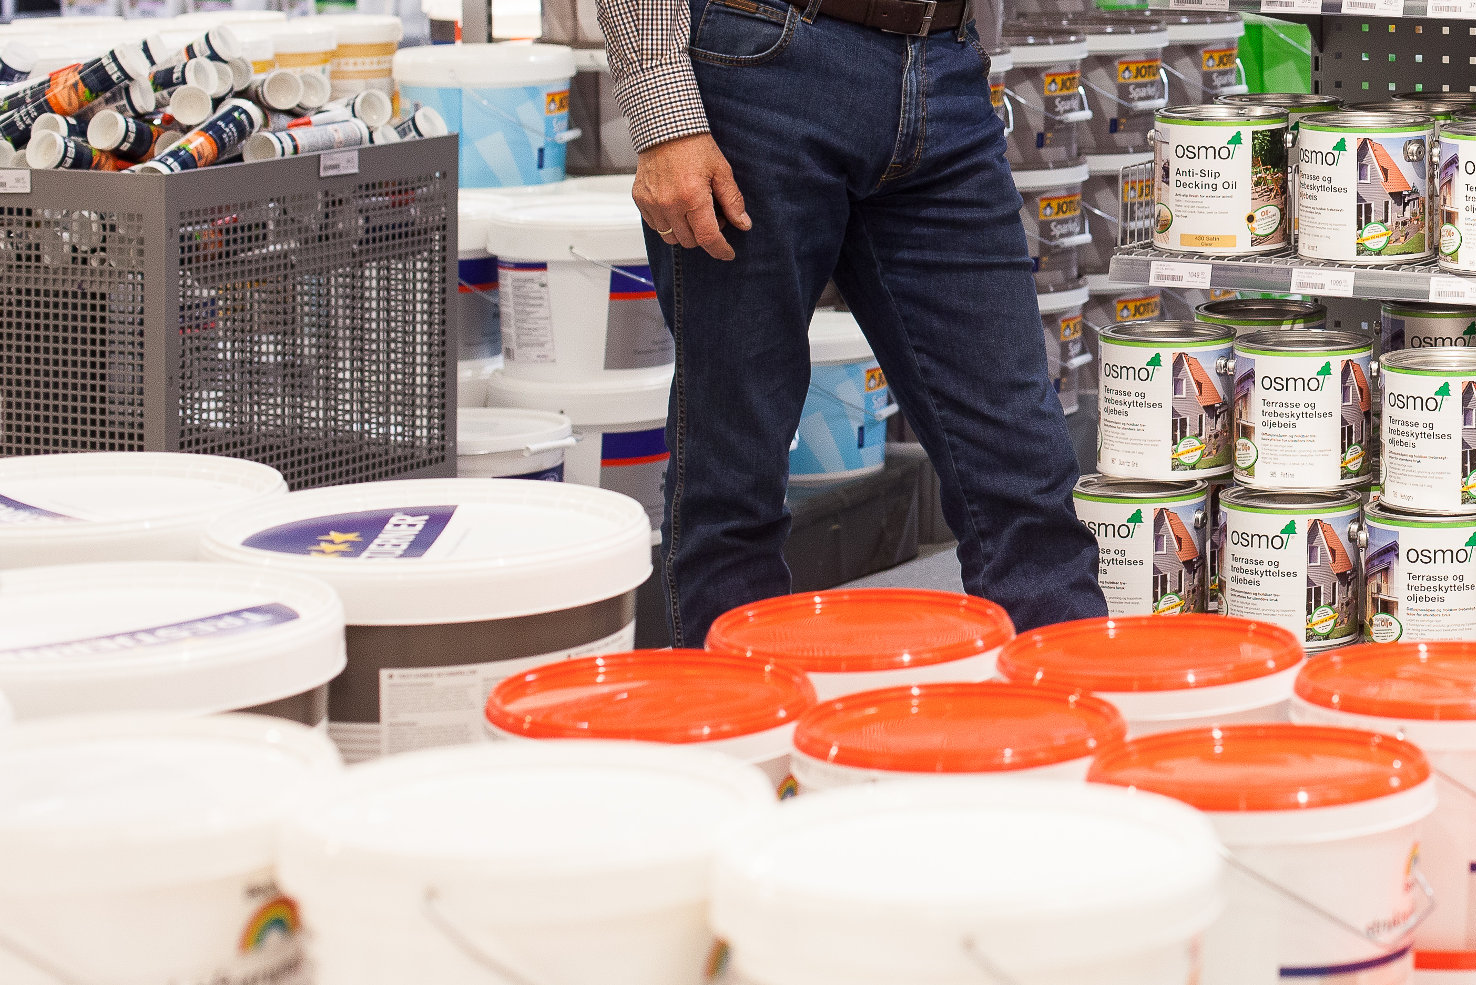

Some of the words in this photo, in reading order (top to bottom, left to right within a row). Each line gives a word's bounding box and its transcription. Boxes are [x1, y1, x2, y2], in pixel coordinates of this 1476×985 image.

[1175, 144, 1232, 160] osmo
[1175, 168, 1221, 180] Anti-Slip
[1175, 180, 1218, 192] Decking
[1222, 181, 1237, 190] Oil
[1104, 363, 1150, 382] osmo
[1261, 375, 1320, 392] osmo
[1104, 385, 1132, 397] Terrasse
[1134, 390, 1146, 399] og
[1261, 399, 1301, 408] Terrasse
[1303, 401, 1316, 410] og
[1388, 391, 1439, 412] osmo
[1261, 409, 1333, 420] trebeskyttelses
[1261, 419, 1297, 429] oljebeis
[1388, 416, 1419, 428] Terrasse
[1422, 420, 1434, 430] og
[1388, 427, 1452, 441] trebeskyttelses
[1388, 438, 1416, 449] oljebeis
[1231, 530, 1284, 550] osmo
[1115, 548, 1126, 557] og
[1406, 547, 1468, 564] osmo
[1231, 554, 1265, 566] Terrasse
[1267, 558, 1279, 568] og
[1231, 565, 1297, 578] trebeskyttelses
[1407, 572, 1449, 582] Terrasse
[1452, 574, 1464, 584] og
[1231, 575, 1261, 587] oljebeis
